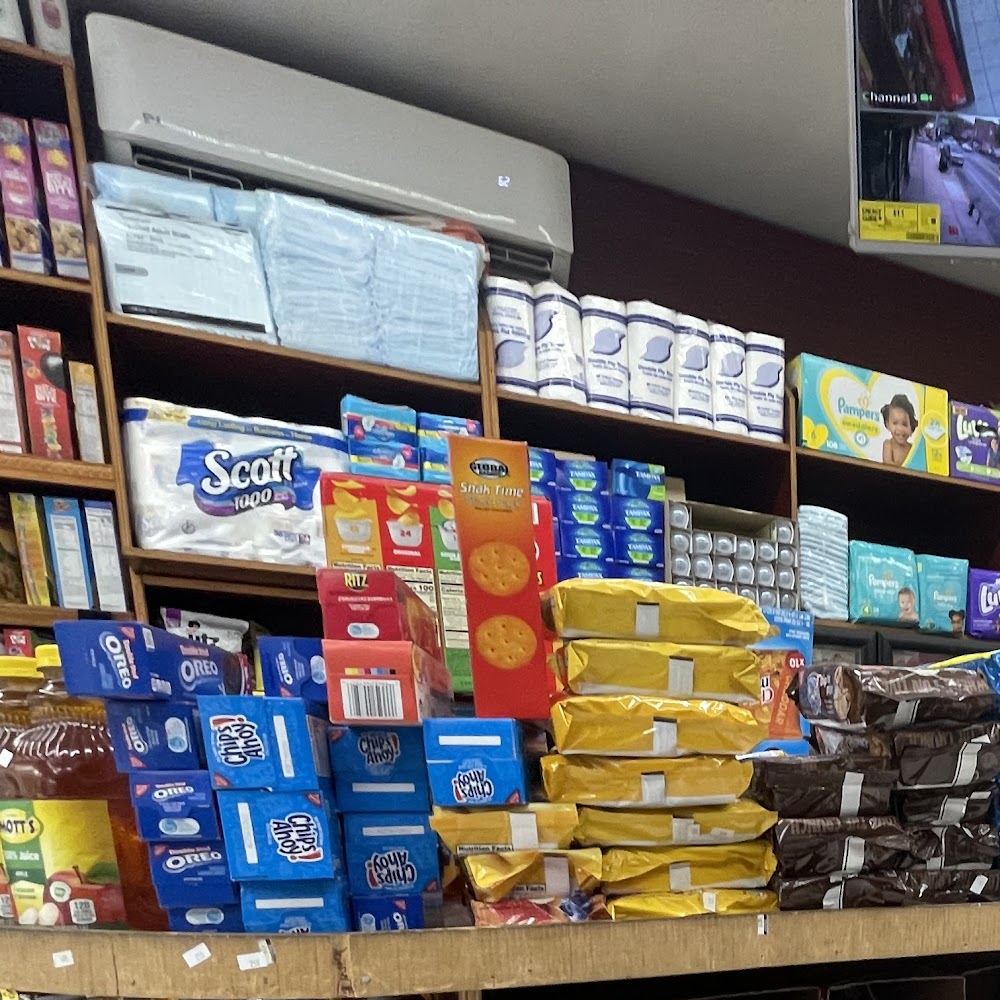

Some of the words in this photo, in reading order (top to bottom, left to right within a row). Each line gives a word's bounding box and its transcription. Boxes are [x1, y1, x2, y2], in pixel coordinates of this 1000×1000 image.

[837, 397, 880, 423] Pampers
[201, 445, 298, 495] Scott
[233, 487, 273, 511] 1000
[460, 482, 490, 495] Snak
[495, 485, 524, 497] Time
[343, 572, 369, 588] RITZ
[868, 573, 900, 589] Pampers
[103, 634, 133, 690] OREO
[180, 659, 218, 684] OREO
[219, 725, 248, 765] Chips
[359, 734, 392, 752] Chips
[152, 785, 195, 801] OREO
[459, 780, 493, 799] Chips
[287, 814, 316, 853] Chips
[165, 850, 222, 872] OREO
[377, 862, 415, 885] Chips
